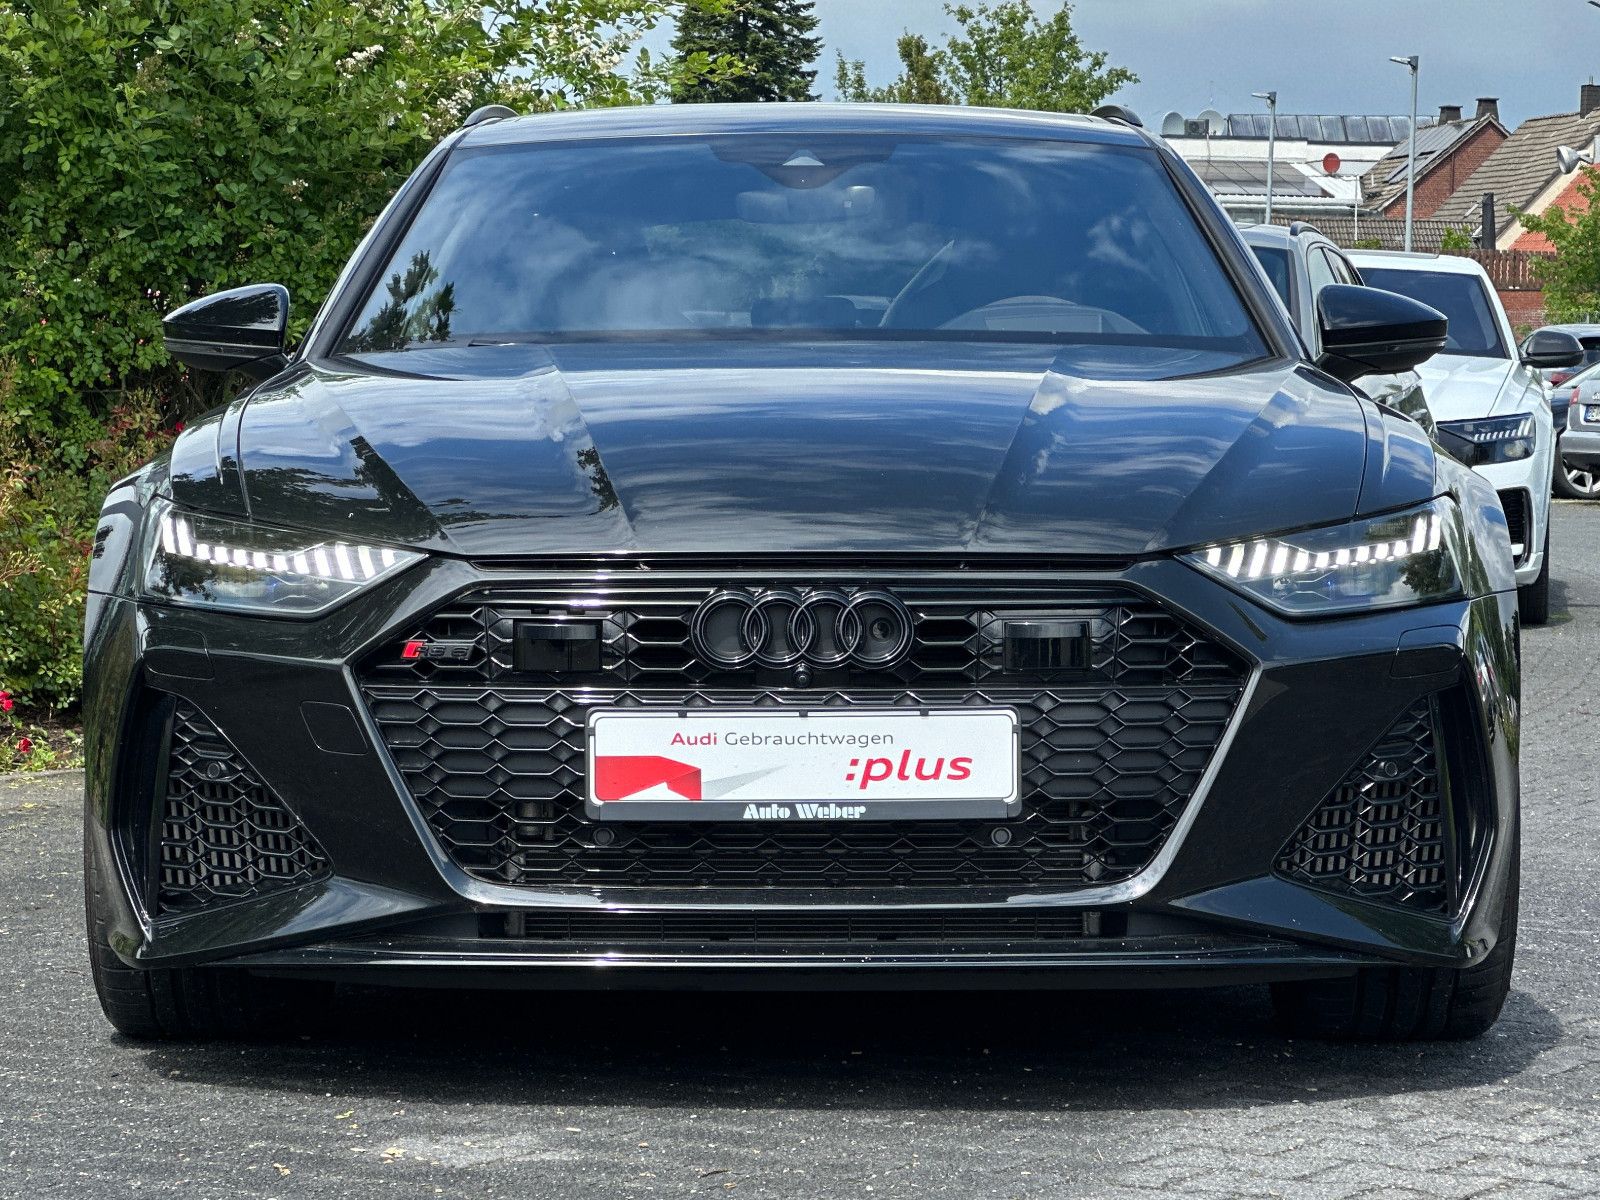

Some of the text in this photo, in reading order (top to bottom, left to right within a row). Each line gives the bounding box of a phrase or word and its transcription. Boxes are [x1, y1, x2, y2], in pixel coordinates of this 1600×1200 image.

[670, 732, 894, 748] Audi Gebrauchtwagen
[845, 749, 973, 790] :plus
[742, 803, 866, 819] Auto Weber
